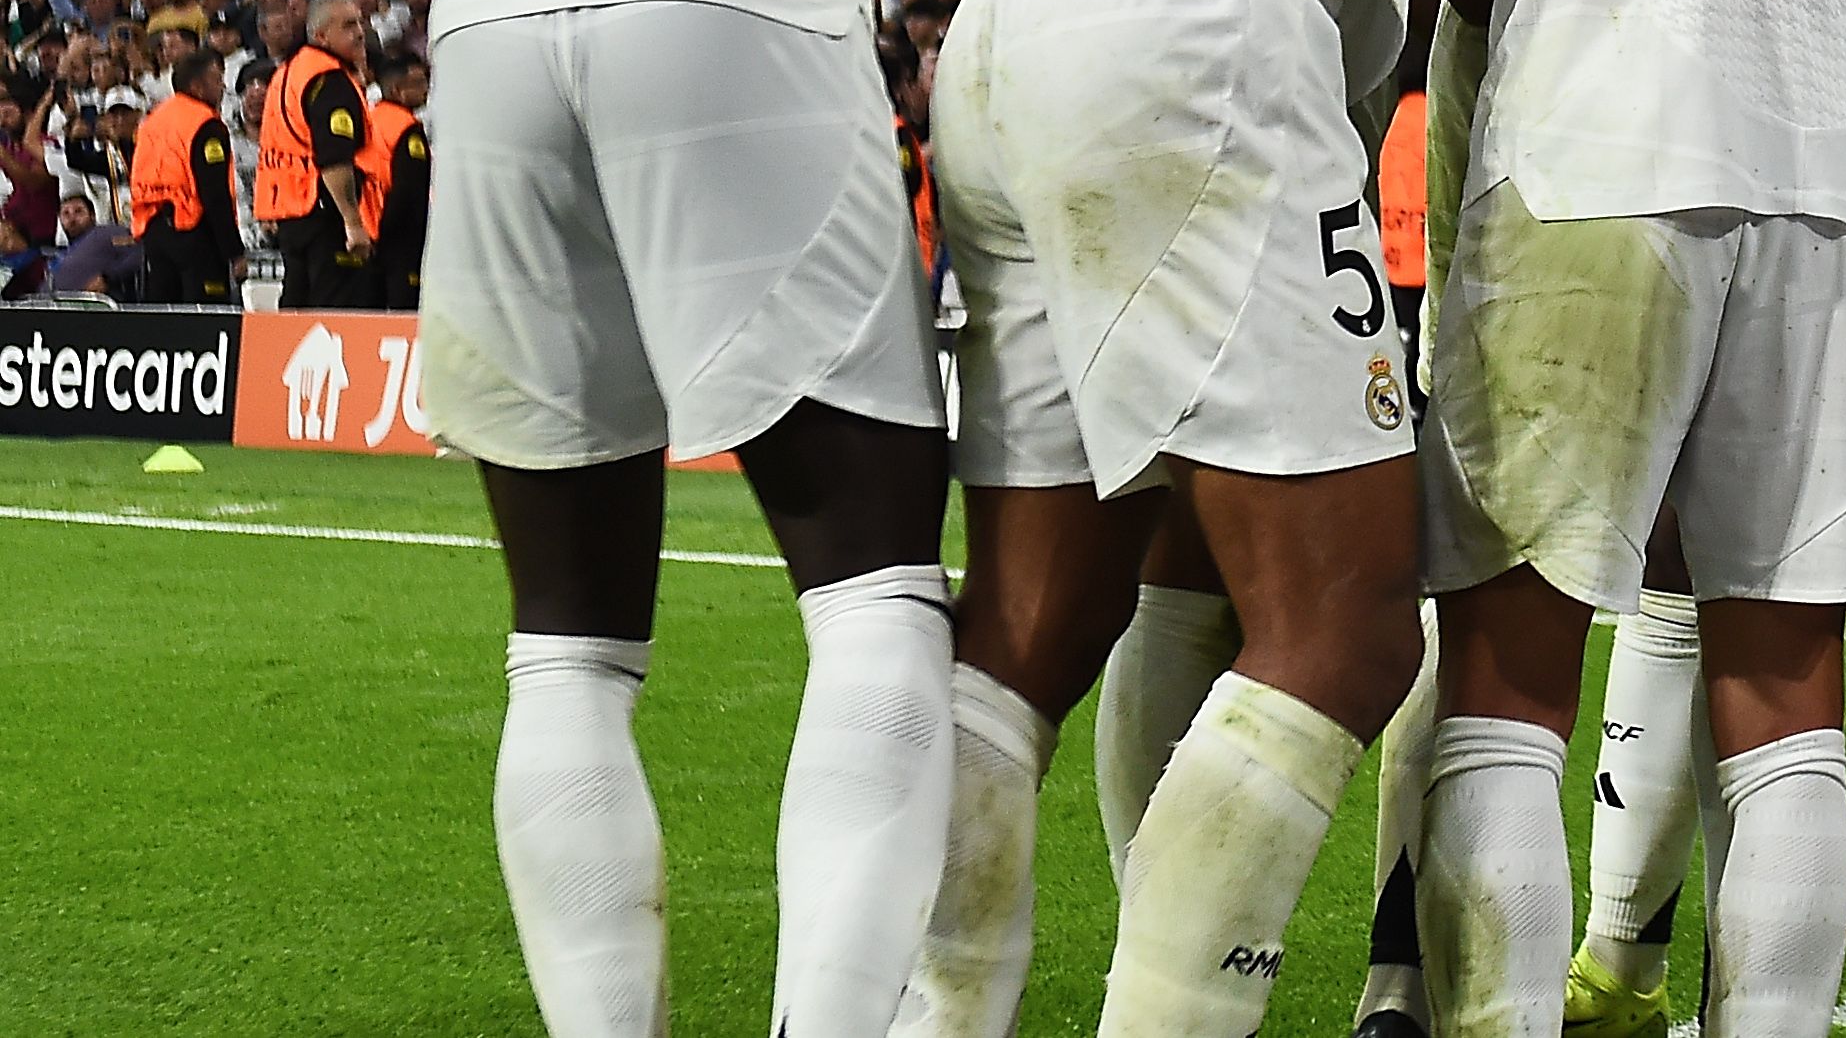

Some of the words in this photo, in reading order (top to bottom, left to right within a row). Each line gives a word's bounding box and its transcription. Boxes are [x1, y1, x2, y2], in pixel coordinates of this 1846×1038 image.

[1317, 198, 1386, 339] 5
[0, 331, 228, 415] stercard
[1602, 720, 1645, 742] CF
